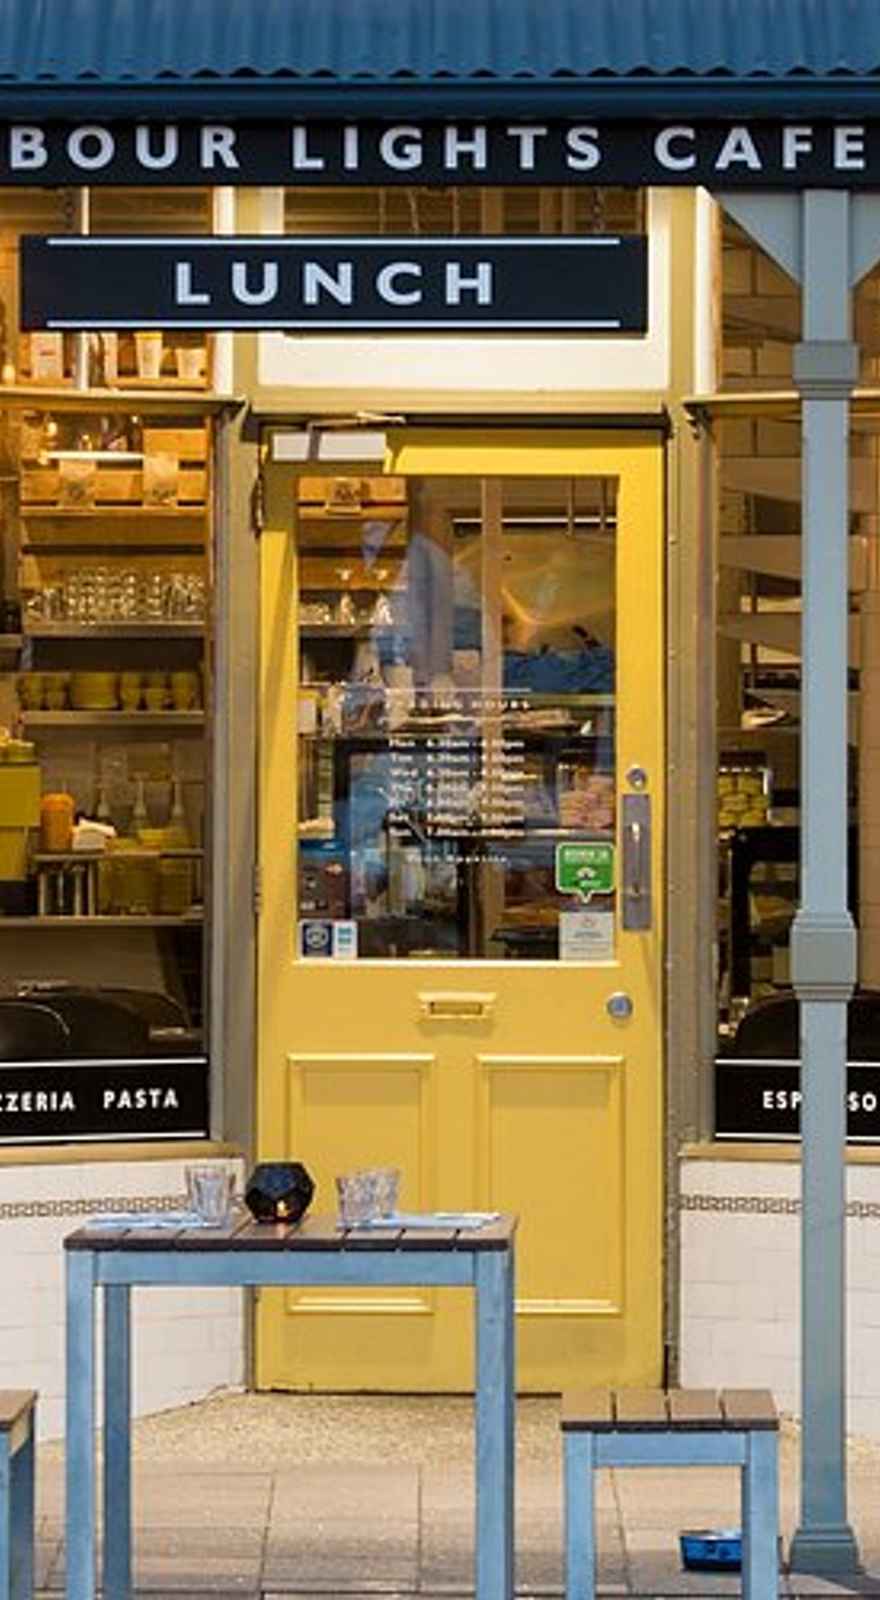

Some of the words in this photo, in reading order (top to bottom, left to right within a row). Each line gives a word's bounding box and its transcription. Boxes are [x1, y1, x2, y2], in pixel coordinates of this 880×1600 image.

[9, 126, 241, 171] BOUR
[292, 126, 602, 171] LIGHTS
[653, 126, 866, 171] CAFE
[175, 262, 494, 305] LUNCH
[0, 1091, 76, 1112] ZERIA
[103, 1088, 179, 1109] PASTA
